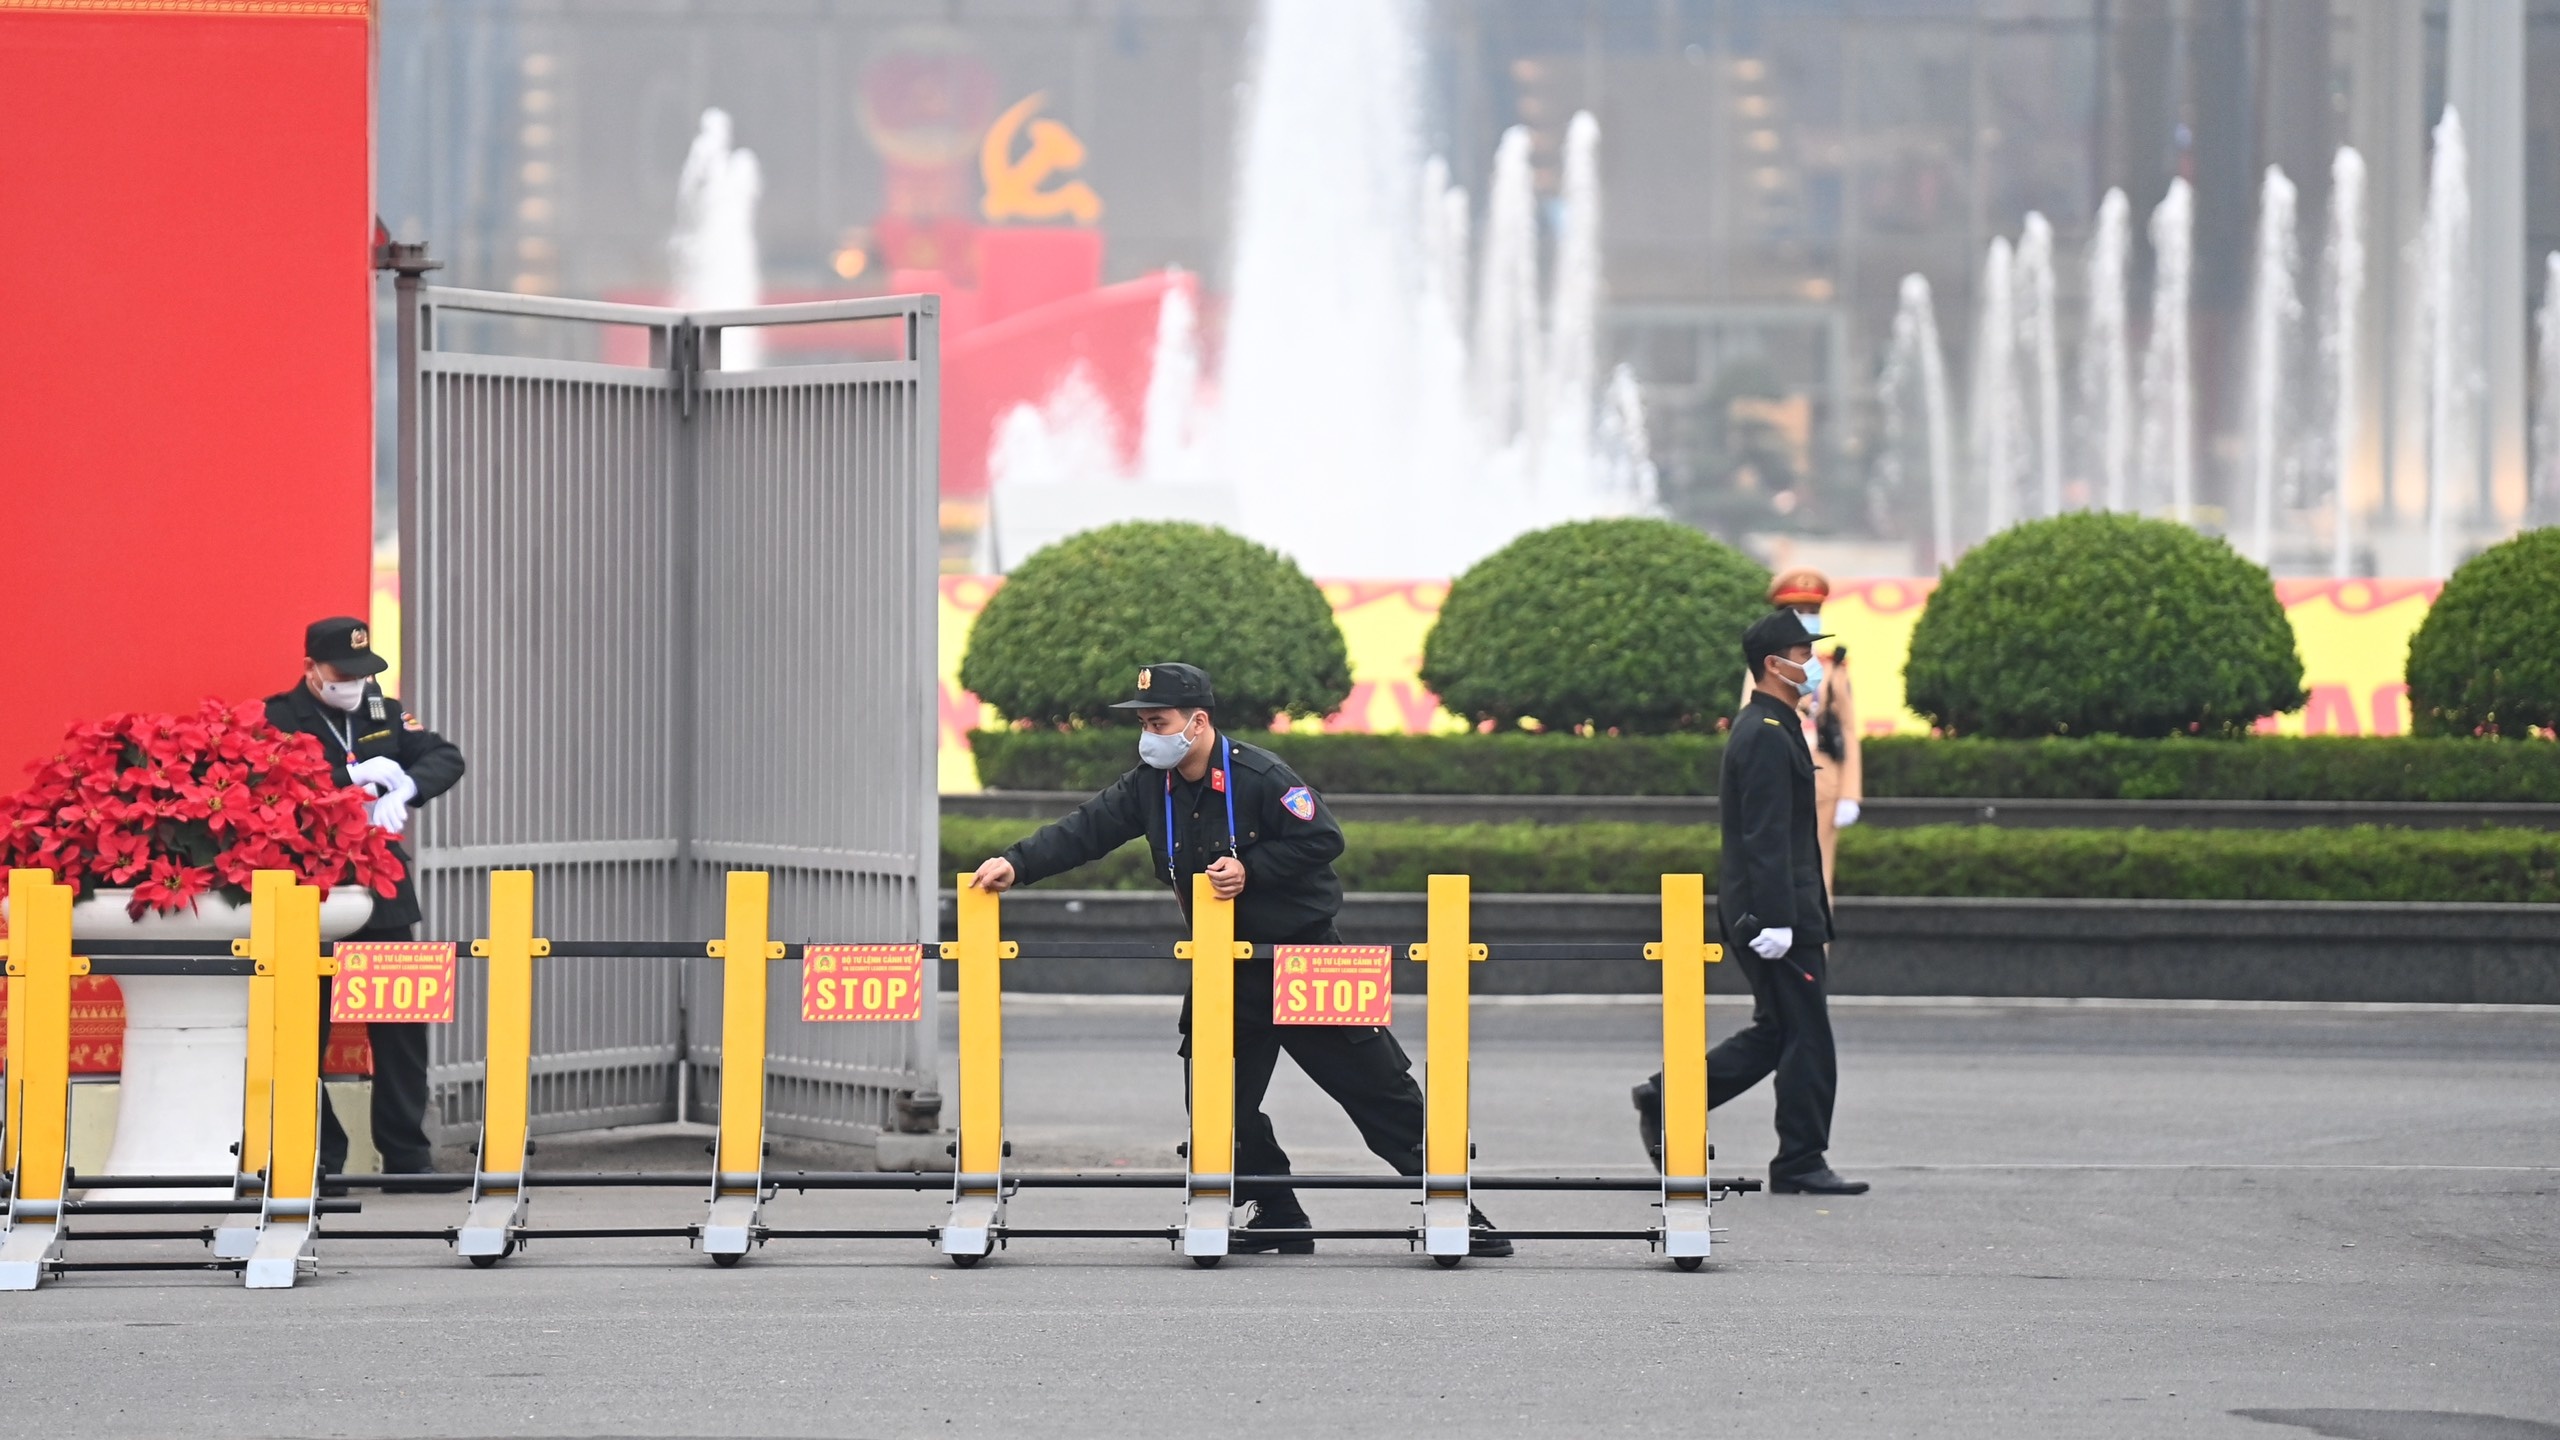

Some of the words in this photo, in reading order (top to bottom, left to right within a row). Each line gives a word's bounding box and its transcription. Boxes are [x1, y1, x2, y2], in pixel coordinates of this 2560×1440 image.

[346, 976, 438, 1009] STOP
[816, 977, 907, 1010] STOP
[1287, 979, 1377, 1012] STOP
